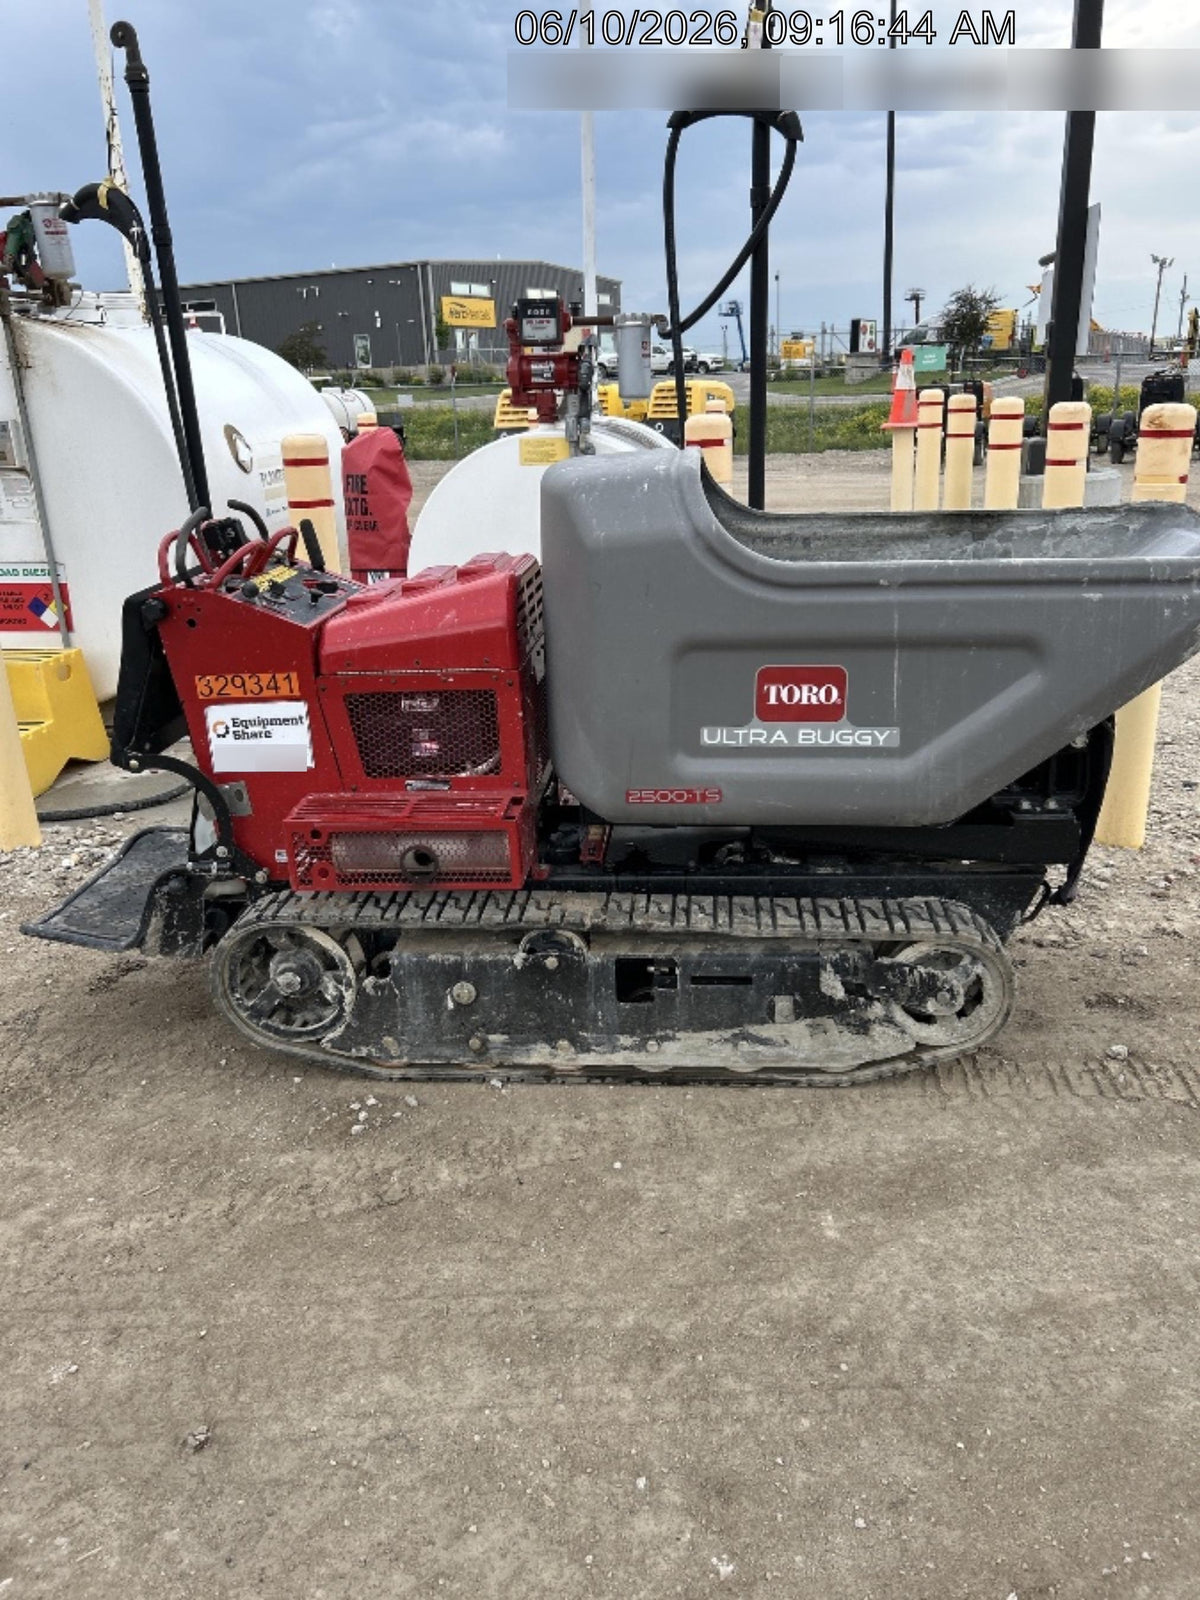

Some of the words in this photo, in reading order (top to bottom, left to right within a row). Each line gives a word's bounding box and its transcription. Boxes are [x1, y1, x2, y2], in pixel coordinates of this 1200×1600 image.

[346, 474, 368, 494] FIRE
[198, 673, 295, 697] 329341
[764, 684, 838, 705] TORO
[231, 714, 304, 729] Equipment
[232, 730, 273, 740] Share
[703, 728, 788, 744] ULTRA
[798, 729, 890, 745] BUGGY
